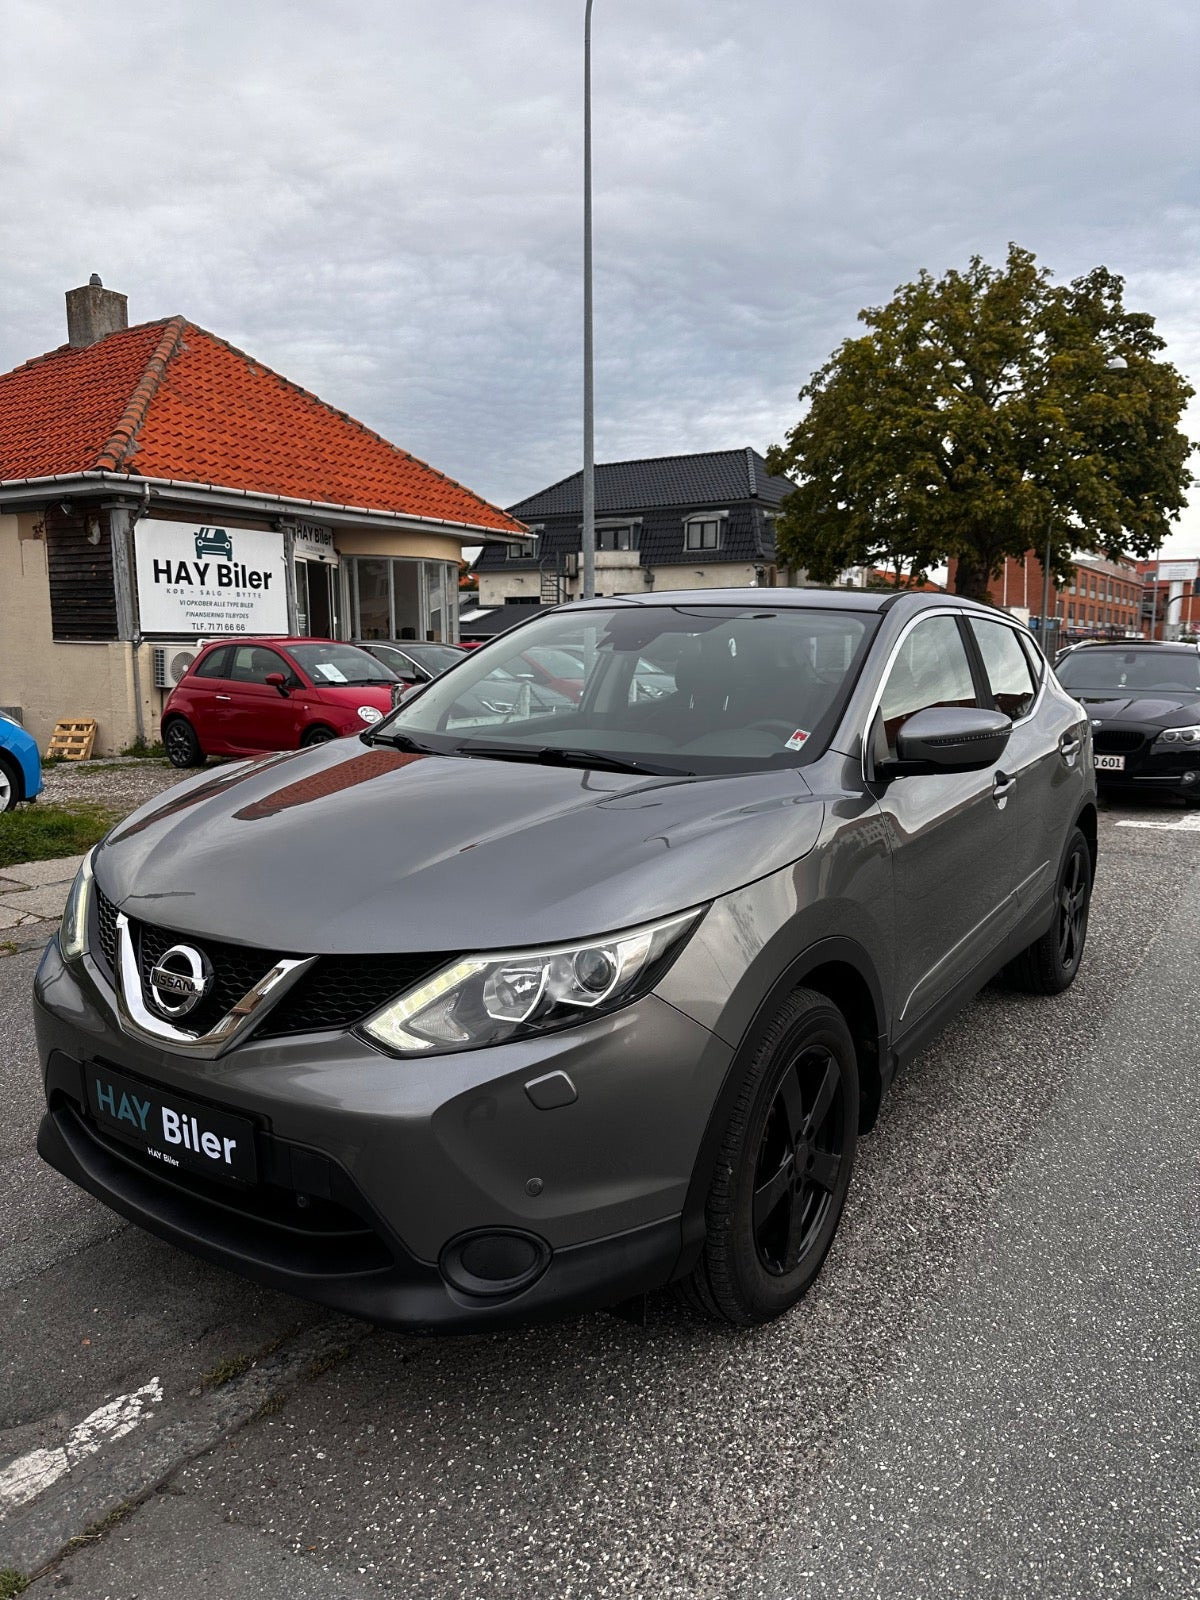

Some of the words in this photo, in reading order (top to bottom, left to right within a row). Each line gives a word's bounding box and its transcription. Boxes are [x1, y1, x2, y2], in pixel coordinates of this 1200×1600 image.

[297, 523, 313, 541] HAY
[315, 527, 331, 546] Biler
[153, 559, 210, 586] HAY
[217, 562, 272, 590] Biler
[200, 589, 222, 597] SALG
[237, 591, 262, 599] BYTTE
[185, 611, 225, 619] FINANSIERING
[192, 622, 207, 631] TLF.
[208, 623, 215, 631] 71
[216, 623, 224, 631] 71
[236, 624, 246, 632] 66
[1101, 757, 1121, 768] 601
[152, 969, 193, 992] NISSAN
[96, 1079, 151, 1132] HAY
[161, 1106, 236, 1165] Biler
[147, 1146, 162, 1160] HAY
[163, 1153, 179, 1167] Biler
